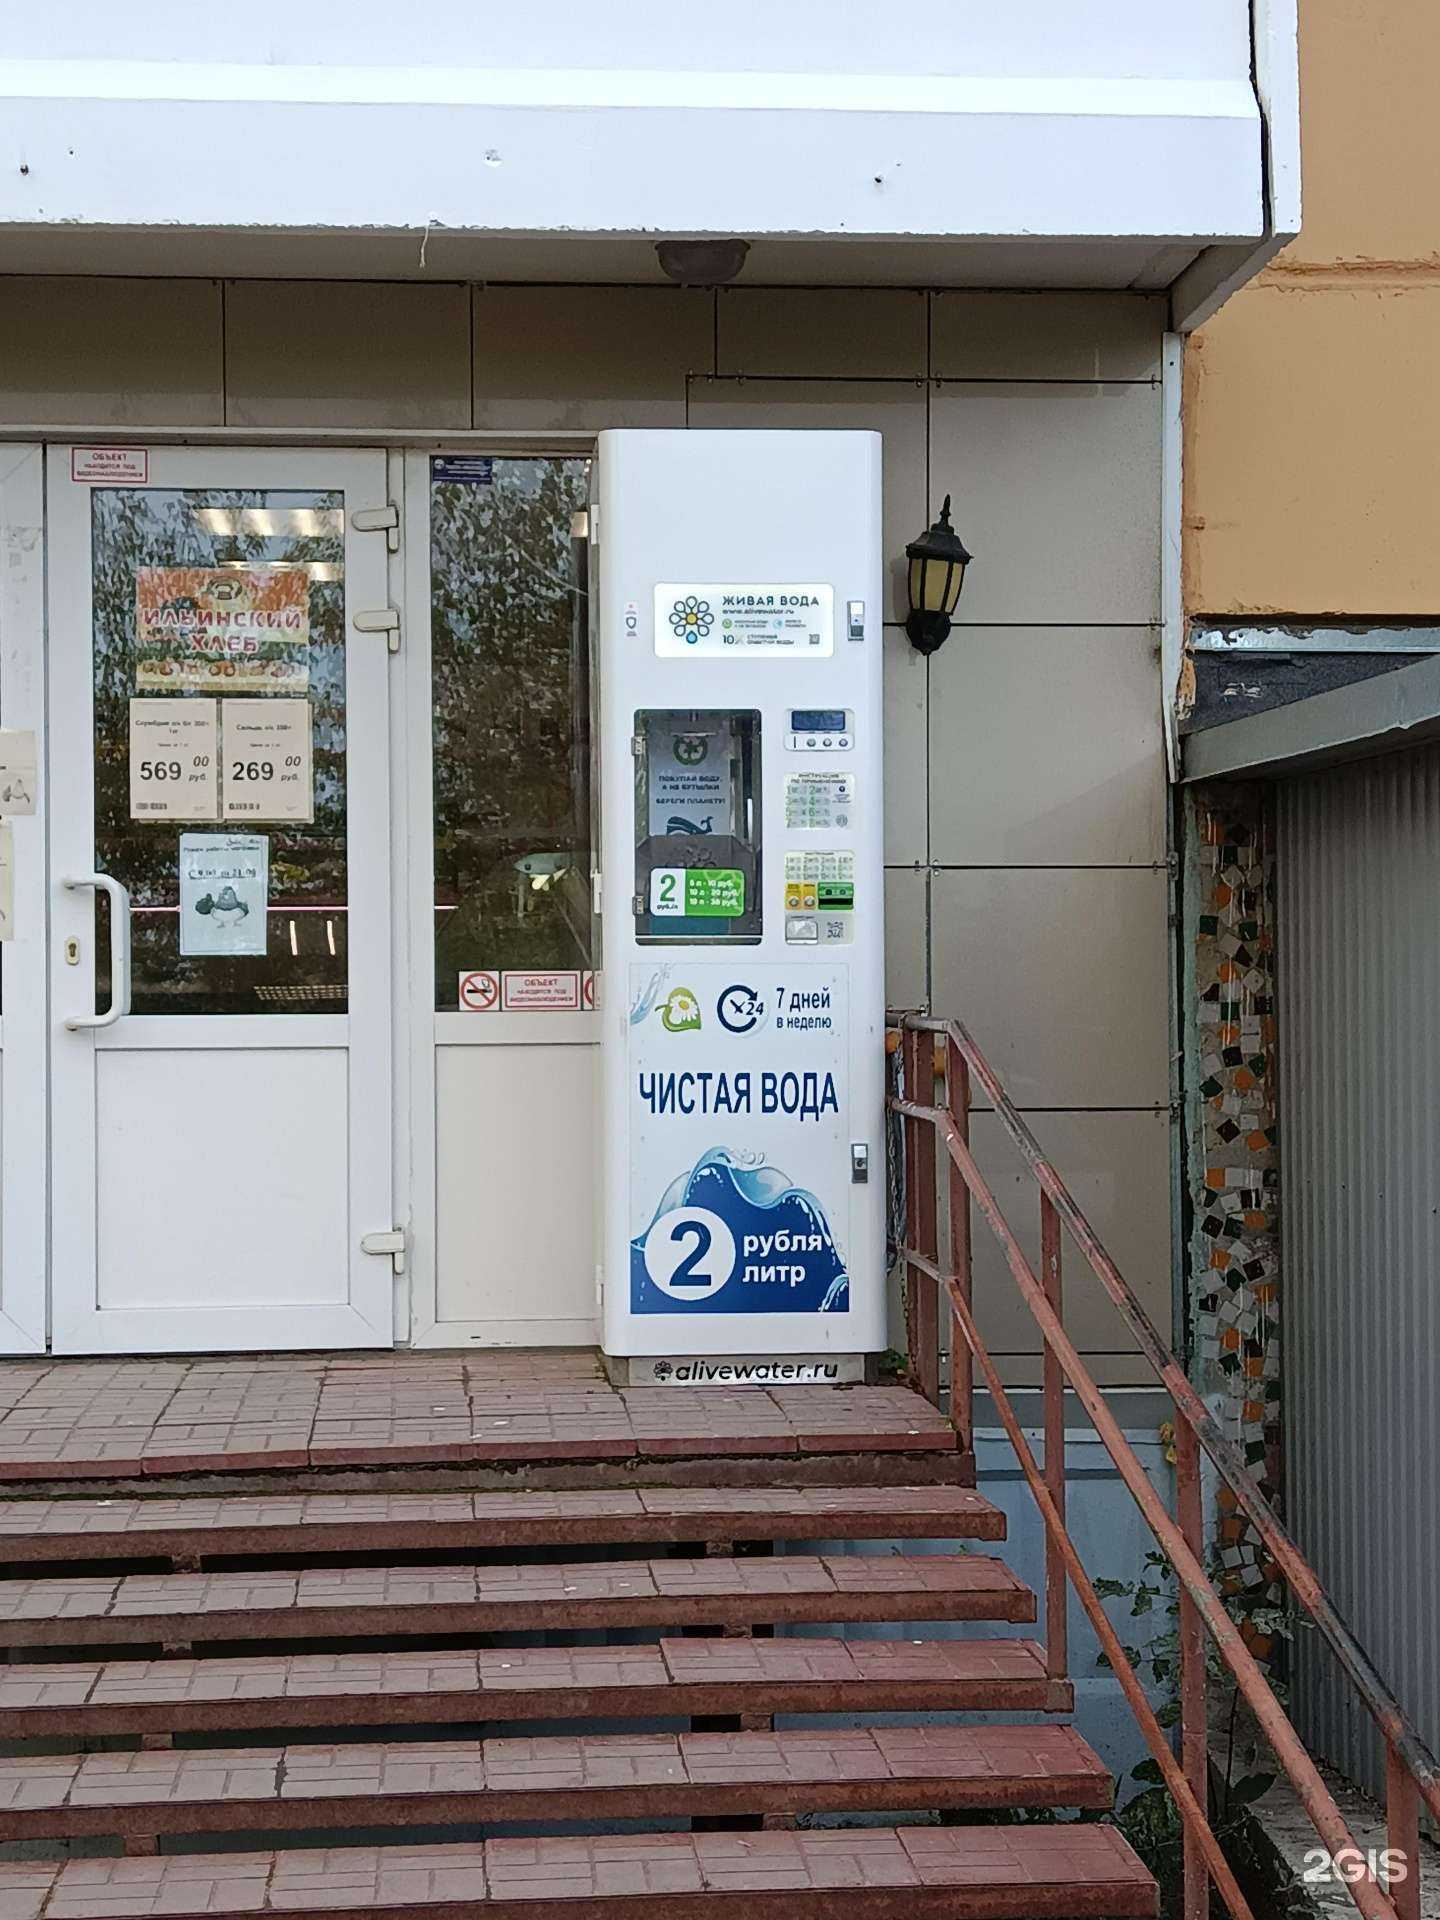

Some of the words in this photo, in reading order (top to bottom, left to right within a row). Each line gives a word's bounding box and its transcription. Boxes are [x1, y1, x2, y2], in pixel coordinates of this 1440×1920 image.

[722, 596, 774, 606] ЖИВАЯ
[780, 596, 819, 607] ВОДА
[191, 635, 259, 652] ХЛЕБ
[140, 761, 182, 781] 569
[193, 755, 210, 767] 00
[232, 761, 274, 781] 269
[285, 755, 301, 767] 00
[660, 874, 676, 902] 2
[524, 979, 558, 987] ОБЪЕКТ
[746, 1001, 764, 1015] 24
[776, 987, 785, 1008] 7
[789, 986, 830, 1013] дней
[776, 1017, 784, 1029] в
[787, 1016, 832, 1031] неделю
[639, 1072, 751, 1114] ЧИСТАЯ
[761, 1072, 839, 1122] ВОДА
[669, 1220, 712, 1287] 2
[743, 1230, 822, 1258] рубля
[742, 1265, 806, 1287] литр
[675, 1361, 838, 1381] alivewater.ru
